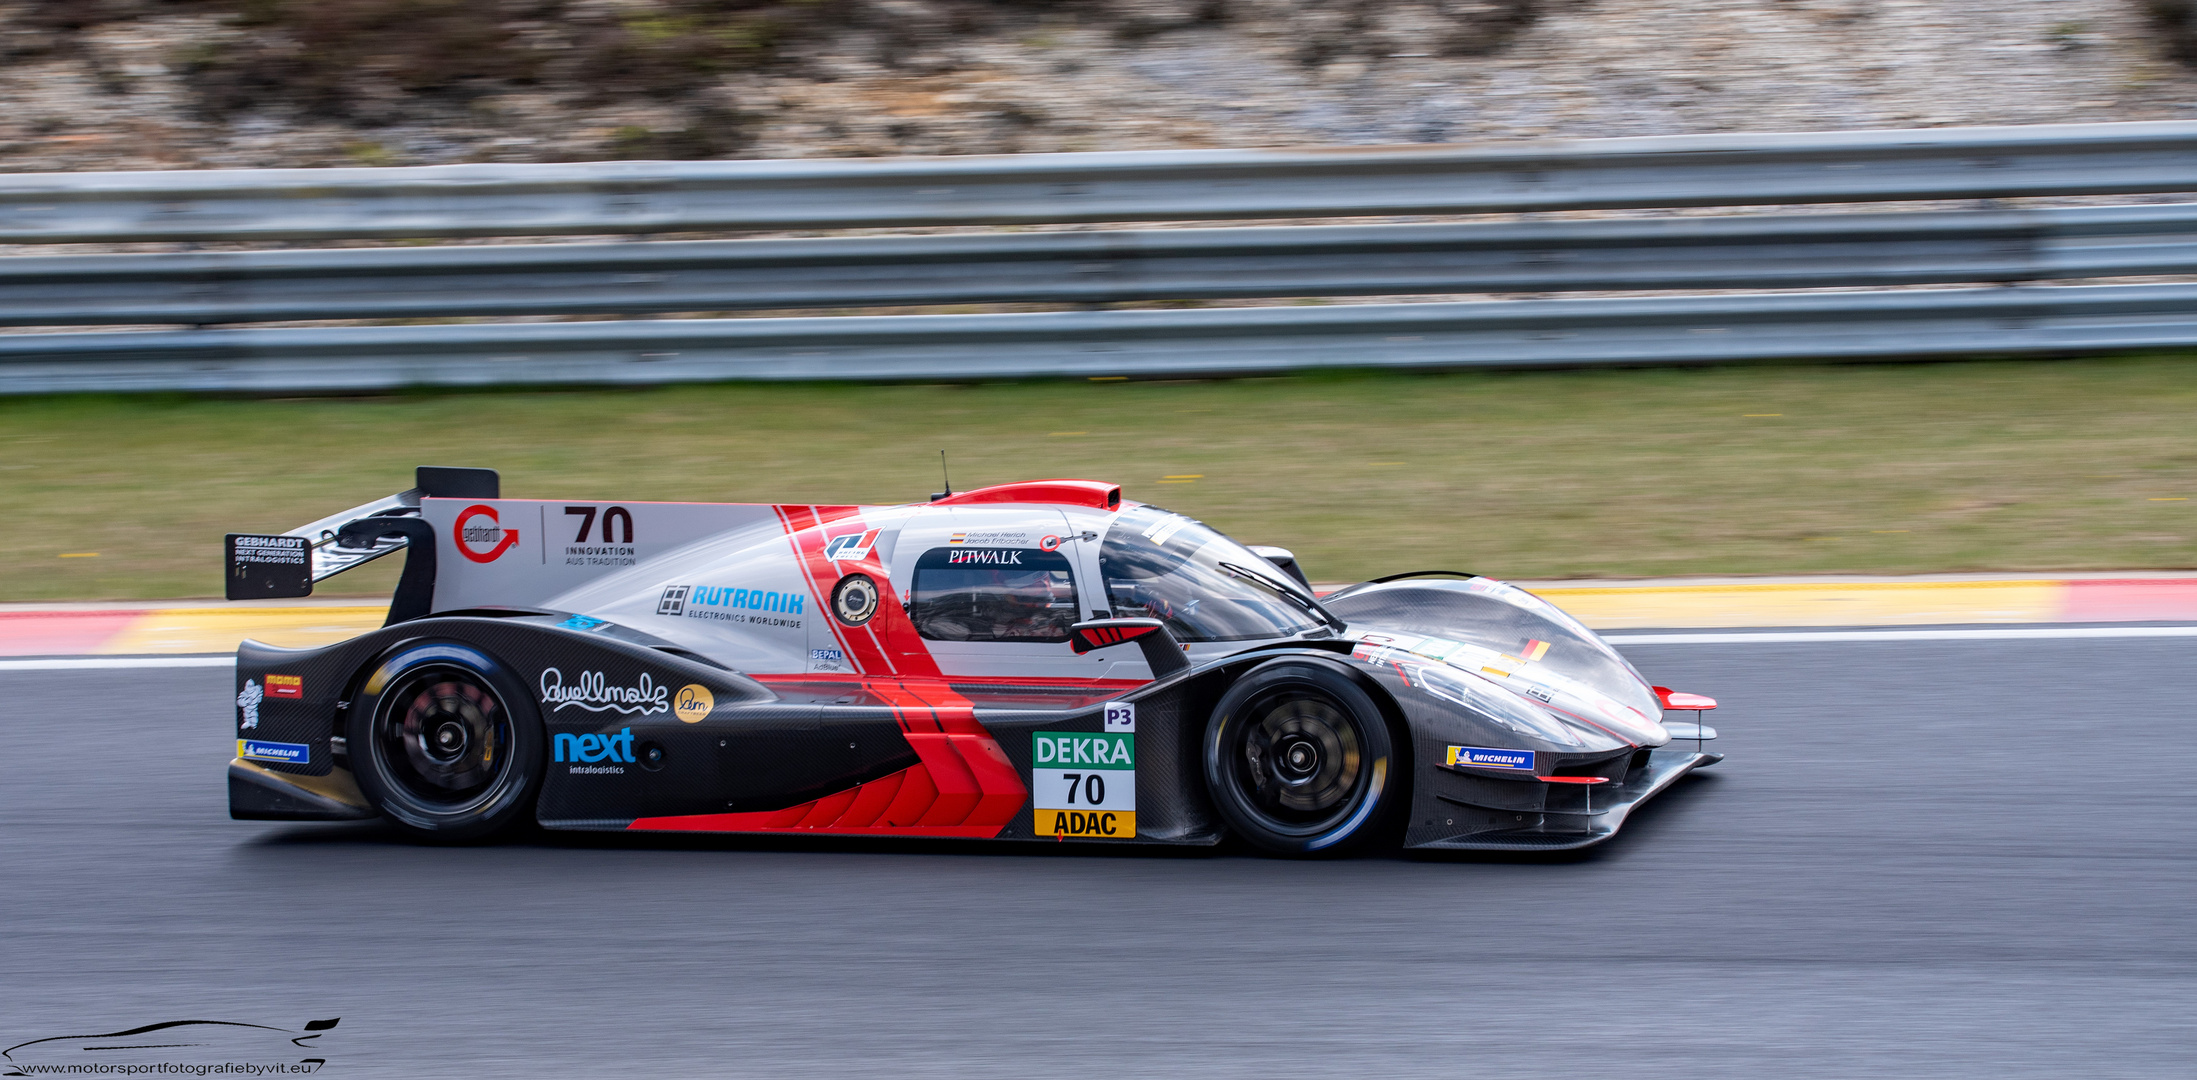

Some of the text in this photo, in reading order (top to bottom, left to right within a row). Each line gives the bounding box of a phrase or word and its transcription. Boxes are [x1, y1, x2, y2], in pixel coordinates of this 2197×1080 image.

[564, 506, 634, 544] 70
[235, 536, 304, 548] GEBHARDT
[256, 549, 305, 558] GENERATION
[565, 546, 635, 556] INNOVATION
[948, 550, 1023, 565] PITWALK
[235, 555, 305, 565] INTRALOGISTICS
[565, 557, 637, 567] AUS TRADITION
[692, 585, 805, 615] RUTRONIK
[688, 610, 802, 629] ELECTRONICS WORLDWIDE
[812, 650, 841, 660] BEPAL
[1107, 709, 1132, 725] P3
[553, 726, 637, 764] next
[1036, 737, 1132, 765] DEKRA
[255, 747, 300, 758] MICHELIN
[1473, 754, 1526, 764] MICHELIN
[569, 765, 625, 775] intralogistics
[1063, 773, 1106, 806] 70
[1053, 811, 1117, 836] ADAC
